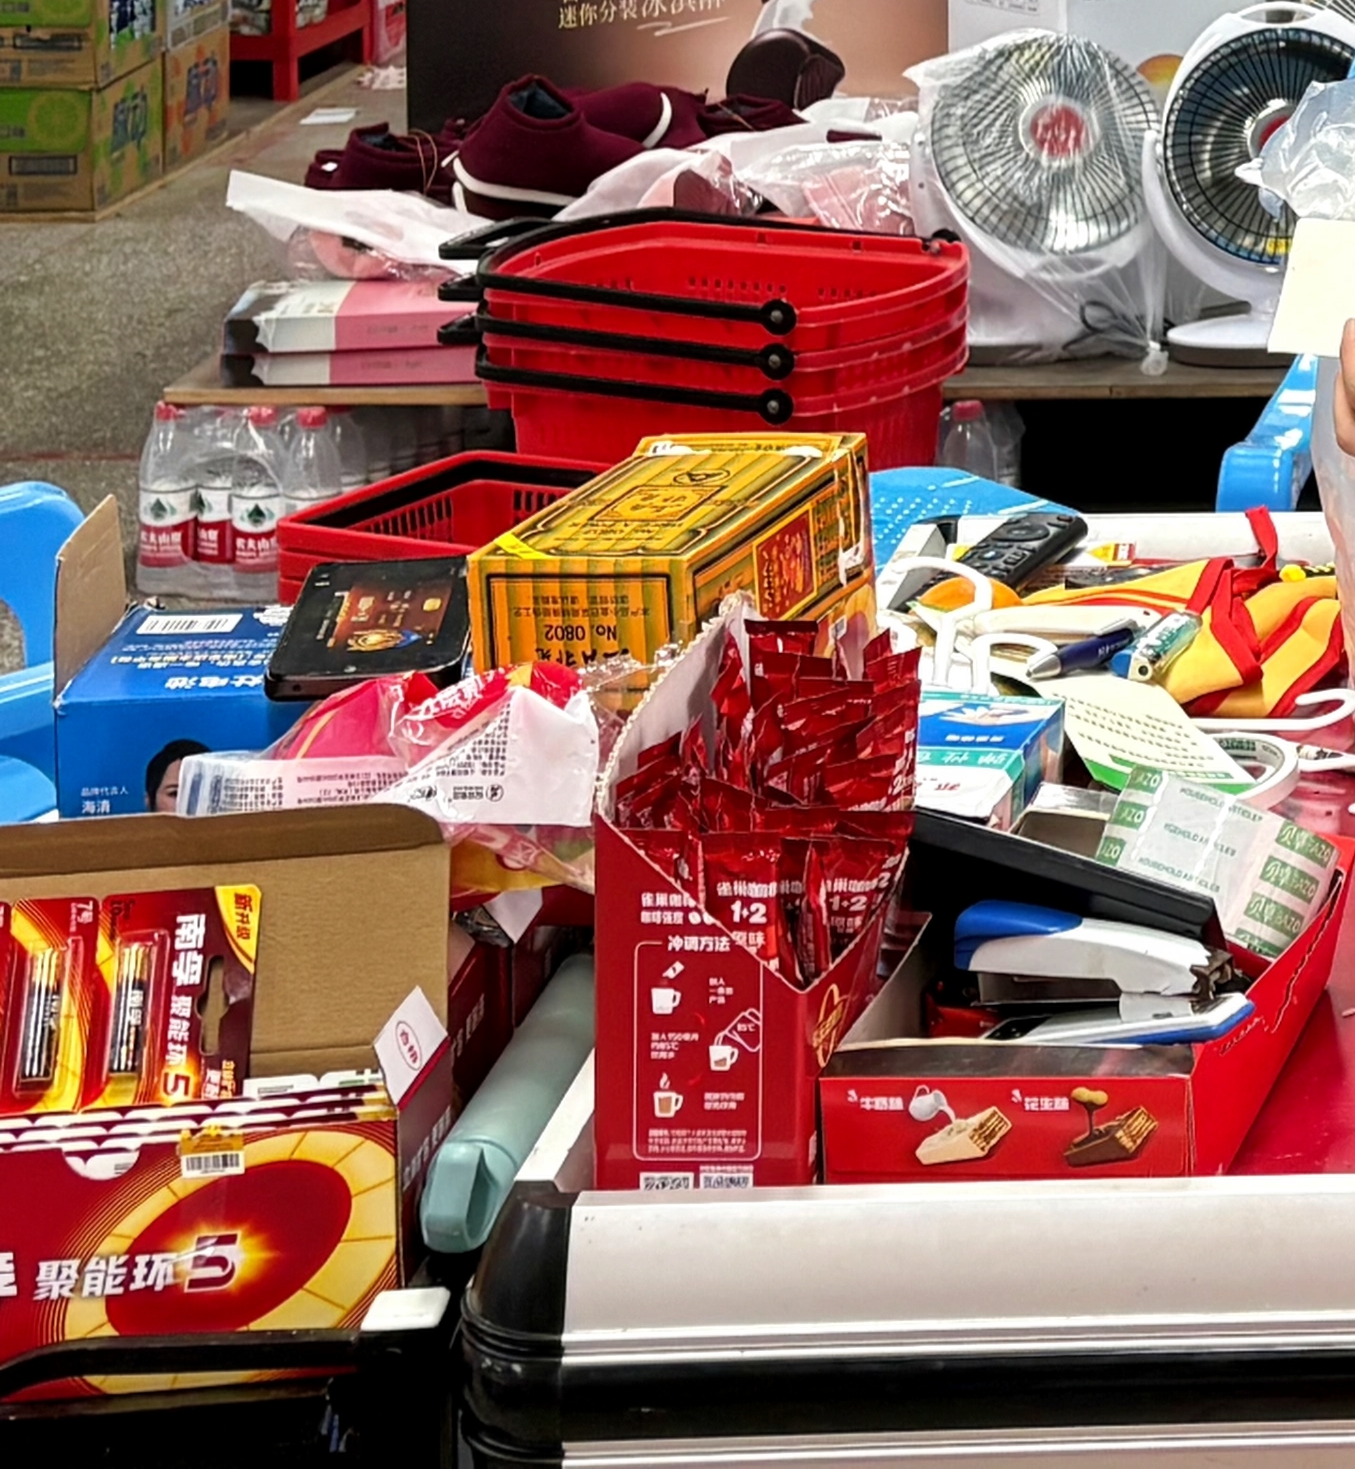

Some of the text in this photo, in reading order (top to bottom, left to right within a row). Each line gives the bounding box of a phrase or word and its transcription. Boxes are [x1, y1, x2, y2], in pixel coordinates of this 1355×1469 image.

[544, 624, 617, 641] No. 0802
[731, 900, 767, 924] 1+2
[171, 914, 206, 987] 南孚
[667, 935, 731, 953] 冲调方法
[34, 1251, 181, 1301] 聚能环
